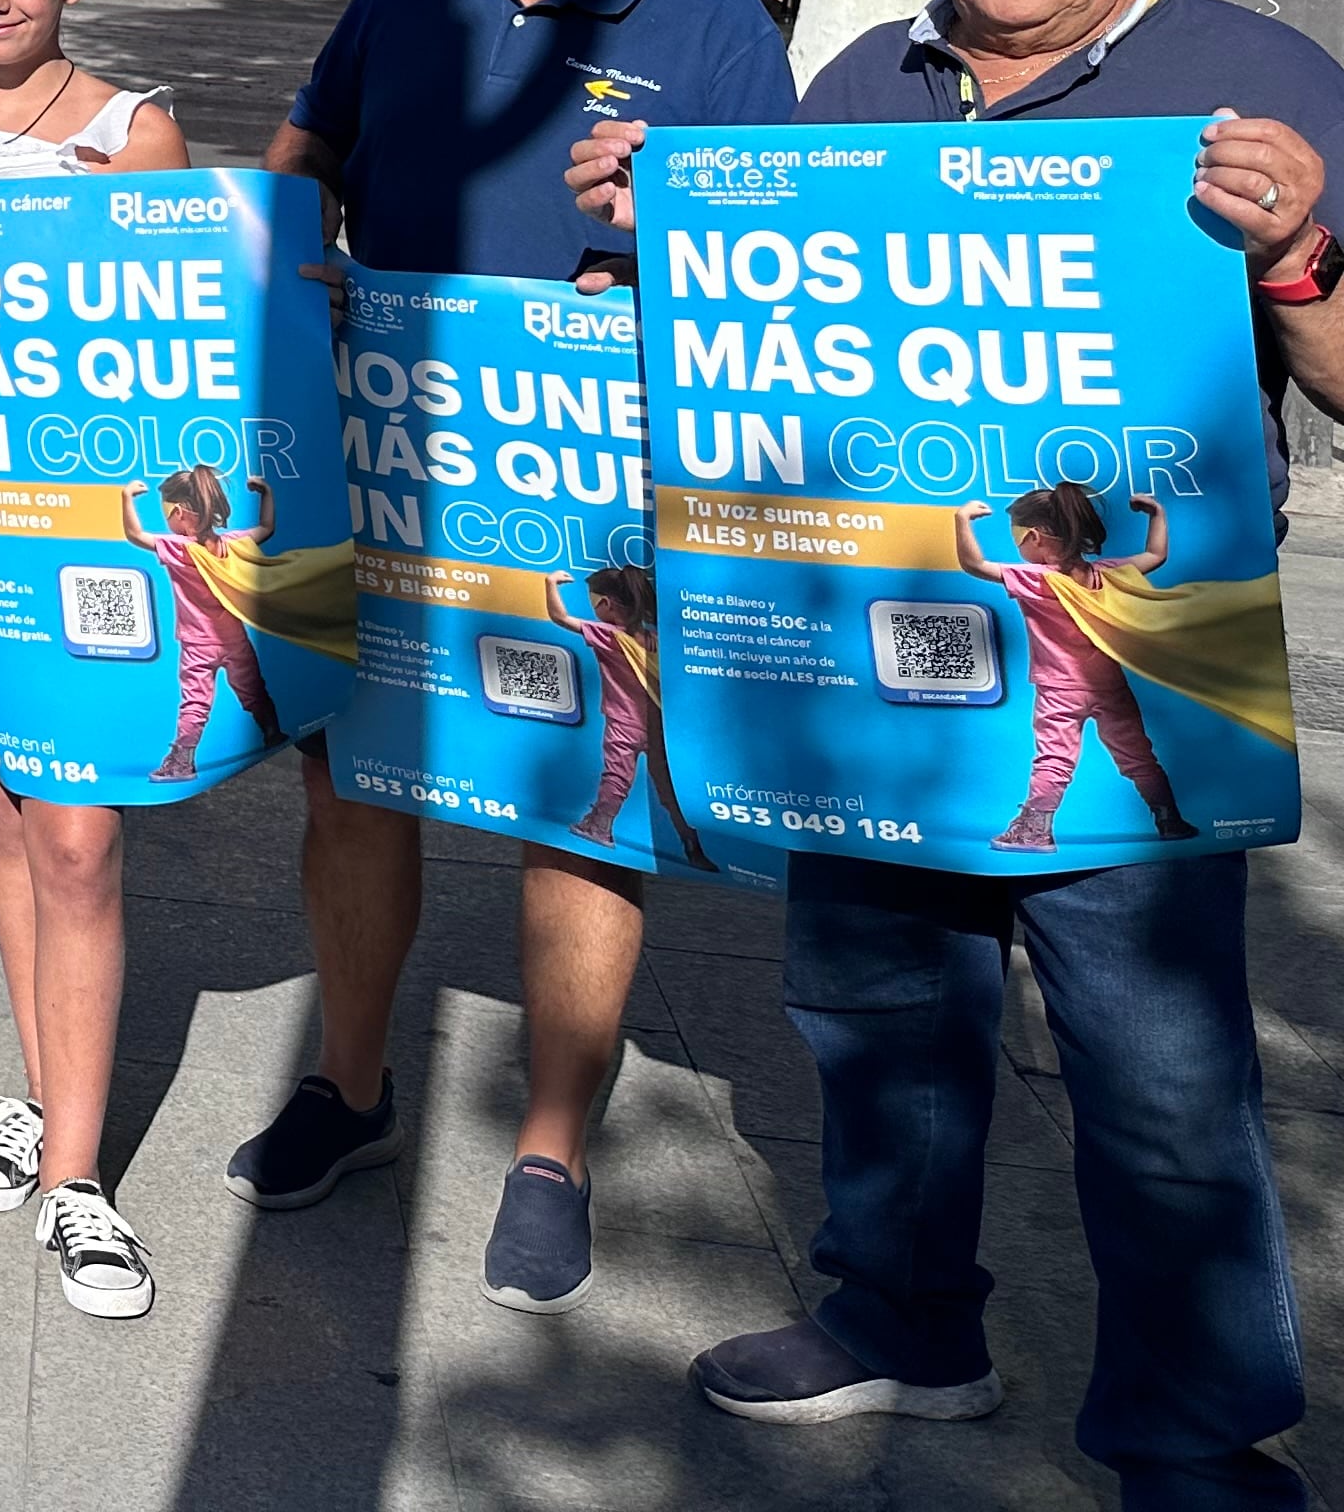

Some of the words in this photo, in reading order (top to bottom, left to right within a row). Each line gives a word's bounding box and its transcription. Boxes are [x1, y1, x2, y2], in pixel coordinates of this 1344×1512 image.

[583, 99, 619, 118] Jaén
[68, 260, 226, 321] UNE
[668, 231, 861, 303] NOS
[886, 233, 1100, 308] UNE
[78, 338, 240, 402] QUE
[674, 306, 874, 396] MÁS
[899, 327, 1120, 406] QUE
[480, 366, 647, 441] UNE
[26, 414, 298, 480] COLOR
[678, 409, 804, 484] UN
[828, 417, 1202, 499] COLOR
[4, 751, 42, 776] 049
[50, 760, 98, 782] 184
[356, 773, 402, 795] 953
[411, 786, 460, 808] 049
[469, 797, 518, 820] 184
[710, 802, 771, 826] 953
[782, 811, 845, 835] 049
[858, 819, 922, 843] 184
